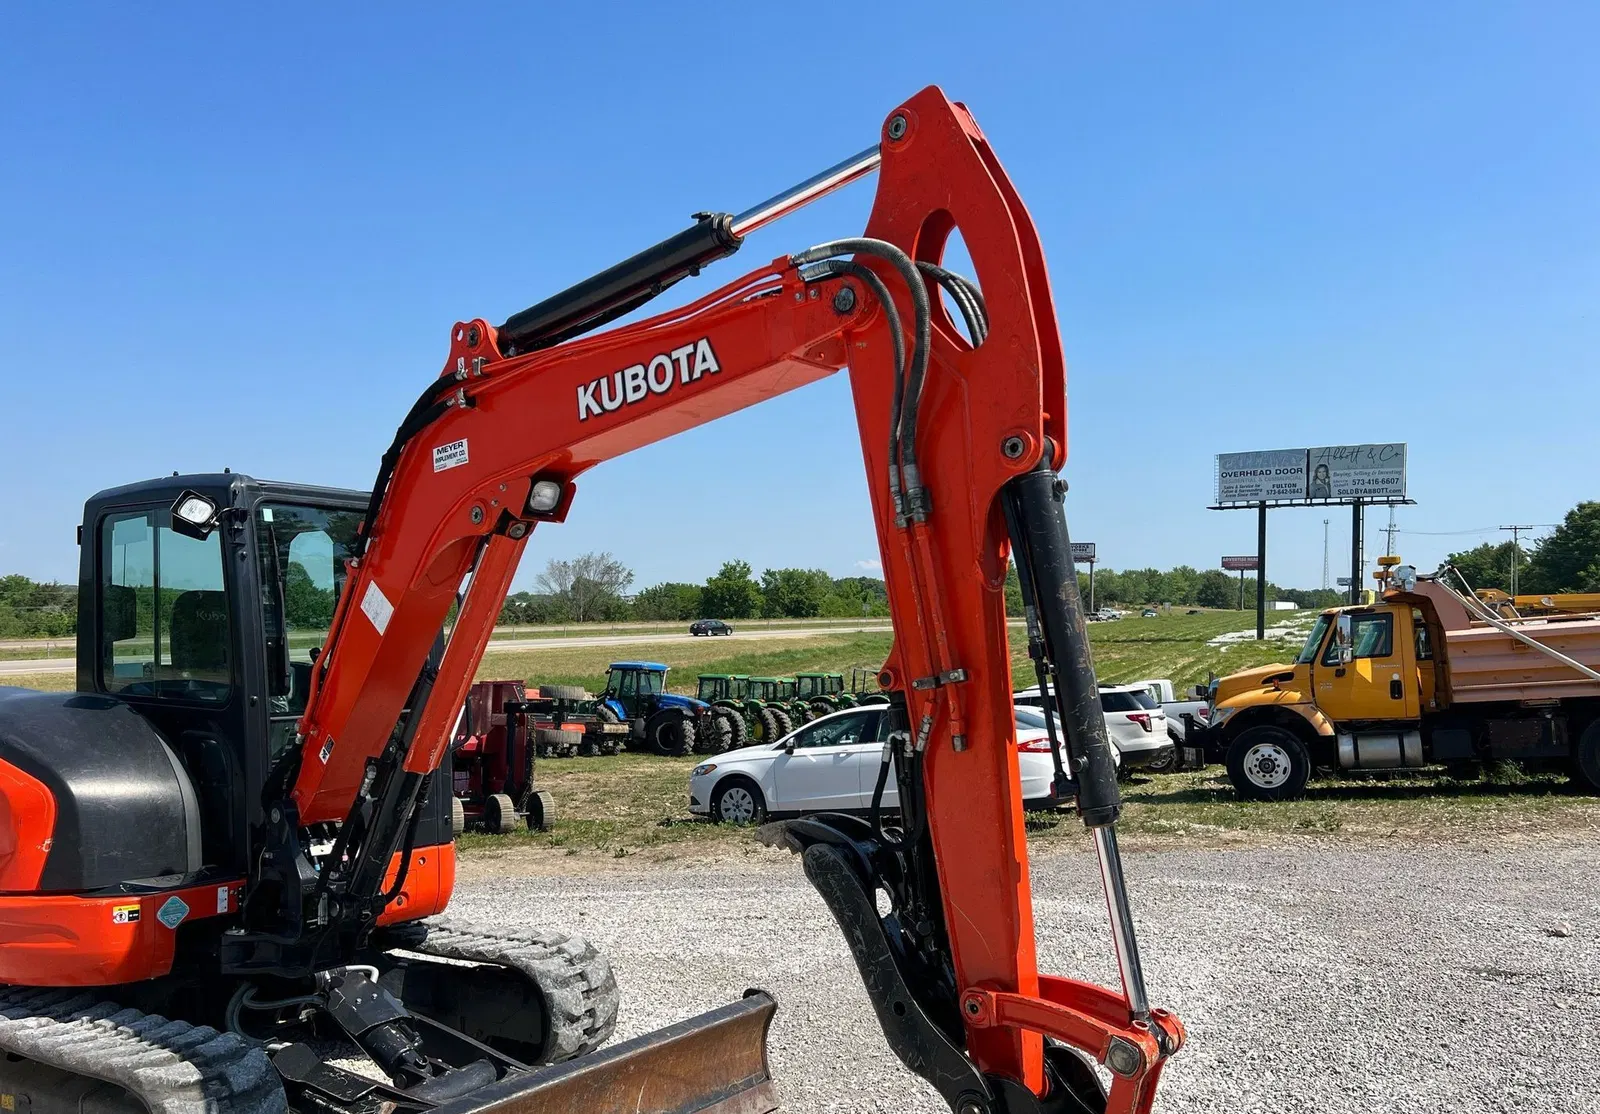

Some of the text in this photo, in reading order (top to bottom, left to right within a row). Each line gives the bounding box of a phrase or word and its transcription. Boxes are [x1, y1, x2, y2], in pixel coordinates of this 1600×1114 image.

[576, 337, 720, 421] KUBOTA
[437, 441, 463, 455] MEYER
[435, 451, 459, 464] IMPLEMENT
[1314, 447, 1364, 465] Abbott
[1367, 447, 1376, 464] &
[1221, 467, 1303, 478] OVERHEAD DOOR
[1352, 477, 1400, 486] 573-416-6607
[196, 610, 227, 621] Kubo
